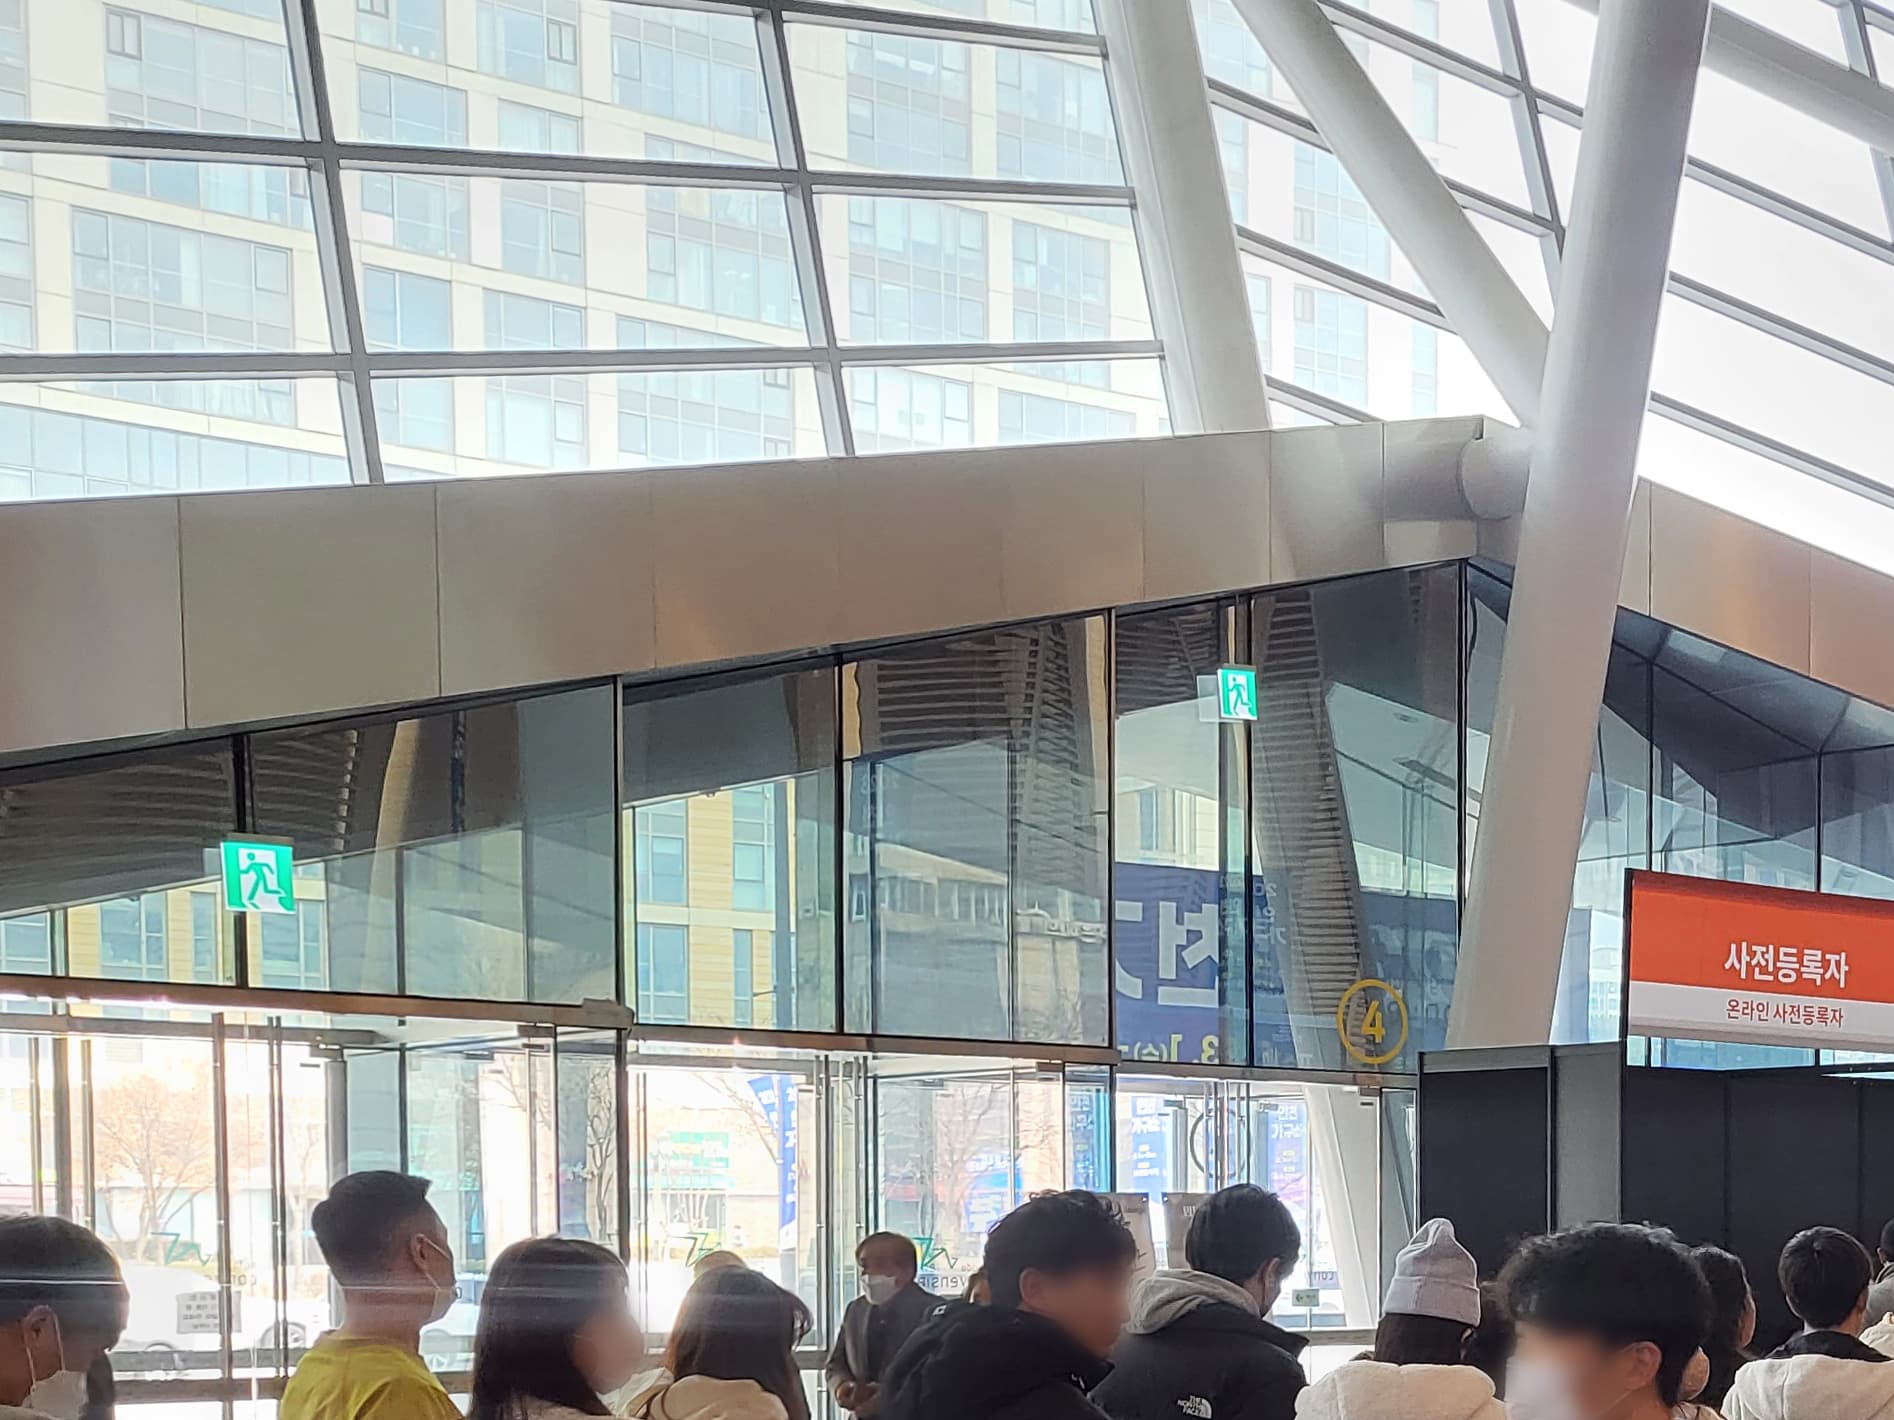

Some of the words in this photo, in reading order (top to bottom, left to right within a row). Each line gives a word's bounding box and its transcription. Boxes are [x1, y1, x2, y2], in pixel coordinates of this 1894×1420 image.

[1723, 941, 1849, 989] 사전등록자
[1361, 1000, 1385, 1043] 4
[1726, 998, 1769, 1022] 온라인
[1773, 1002, 1844, 1029] 사전등록자
